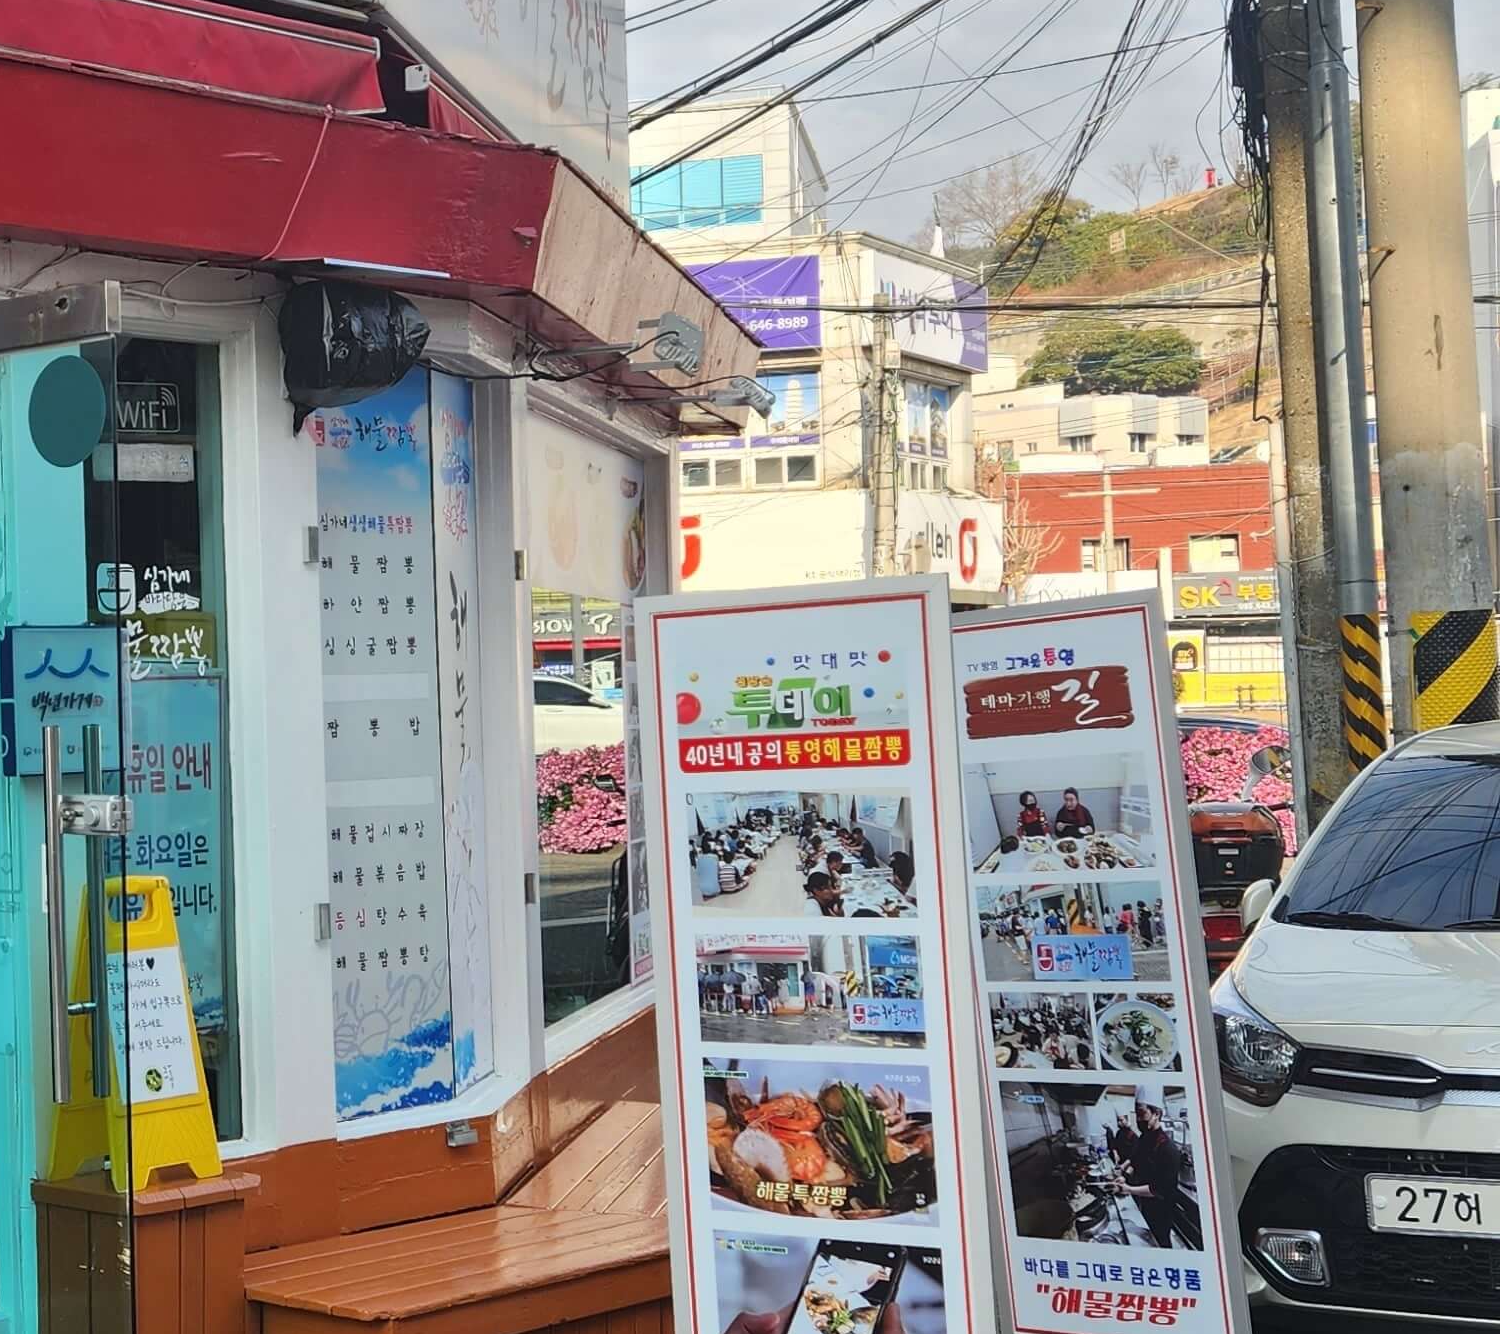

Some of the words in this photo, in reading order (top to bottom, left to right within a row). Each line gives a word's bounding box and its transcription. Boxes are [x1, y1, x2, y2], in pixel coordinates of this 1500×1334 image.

[115, 386, 168, 429] WiFi
[143, 565, 191, 594] 심가네
[1179, 585, 1222, 609] SK
[125, 618, 207, 681] 물짬뽕
[967, 663, 979, 673] TV
[171, 741, 213, 791] 안내
[135, 831, 210, 870] 화요일은
[1395, 1185, 1483, 1226] 27허
[1023, 1257, 1070, 1280] 바다를
[1076, 1261, 1124, 1283] 그대로
